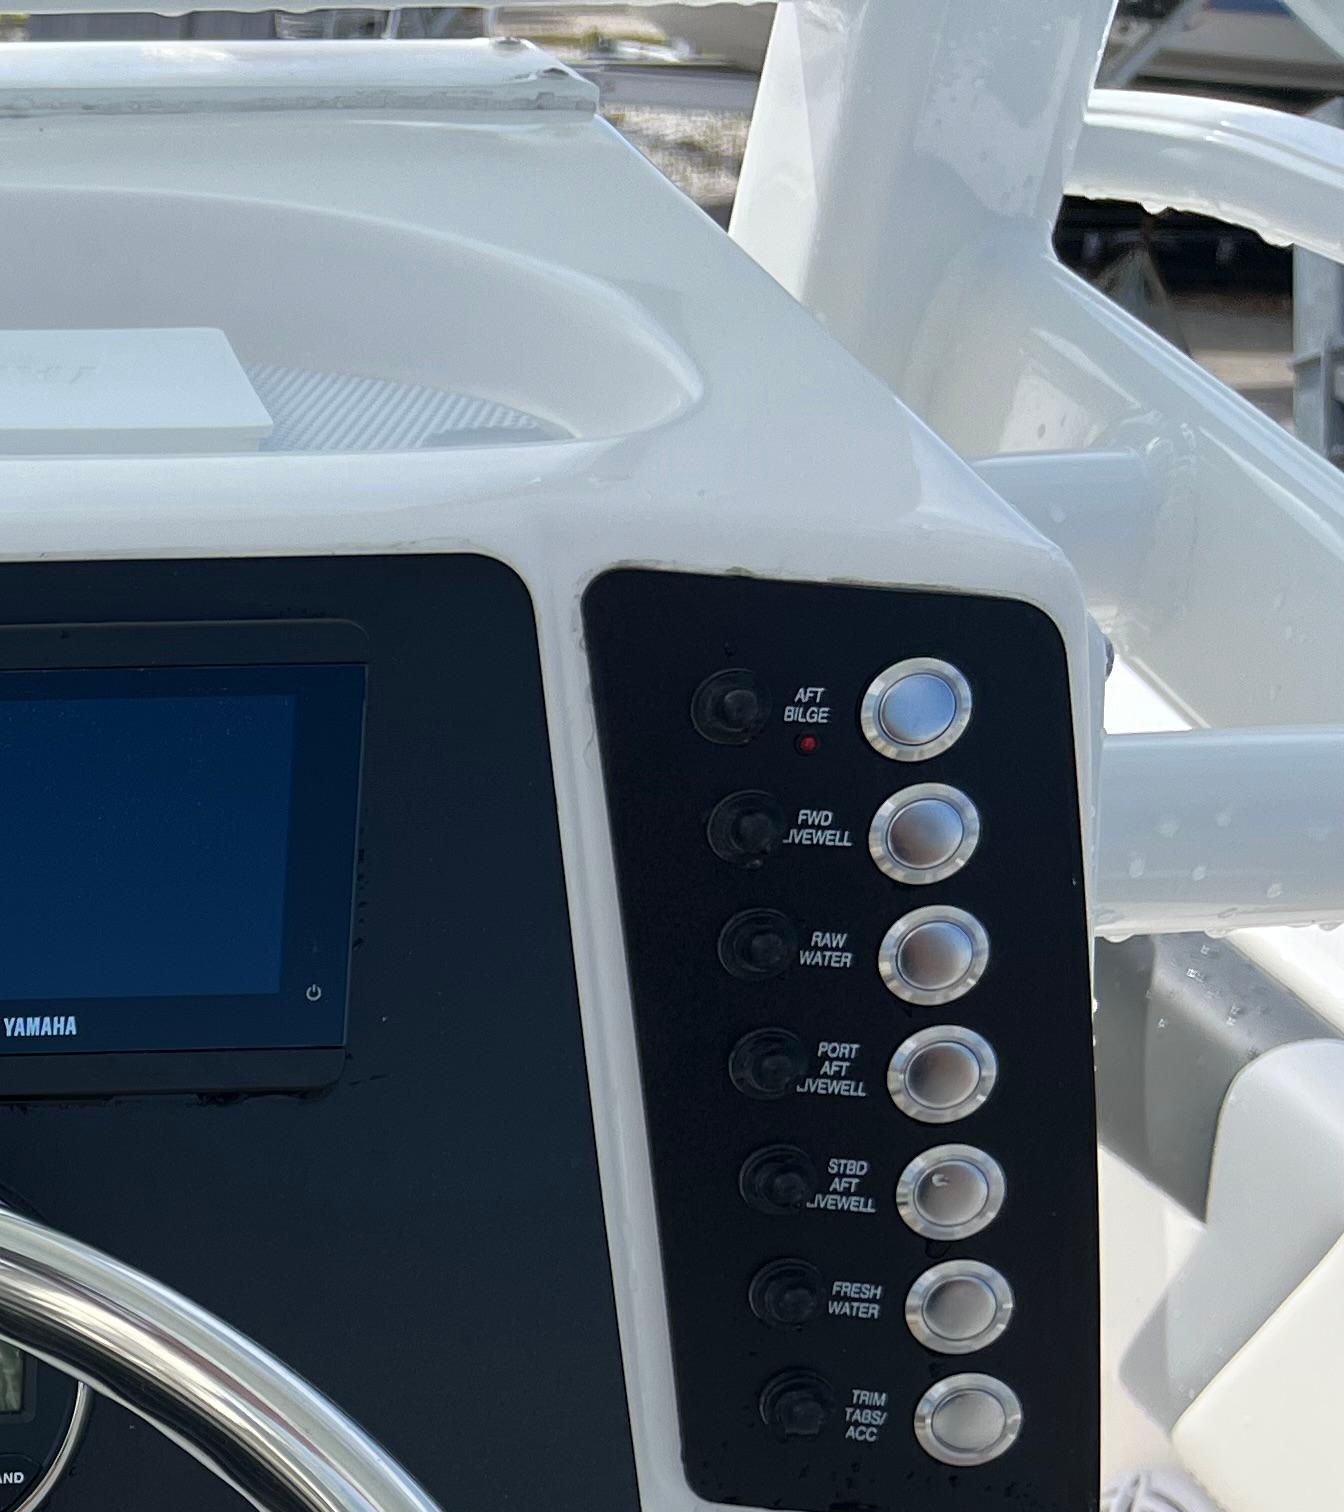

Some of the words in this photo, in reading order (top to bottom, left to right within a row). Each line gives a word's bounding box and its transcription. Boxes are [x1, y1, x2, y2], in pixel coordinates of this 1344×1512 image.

[794, 687, 825, 703] AFT
[784, 706, 829, 723] BILGE
[797, 809, 833, 826] FWD
[811, 931, 847, 948] RAW
[799, 950, 852, 968] WATER
[3, 1015, 76, 1037] YAMAHA
[817, 1042, 860, 1059] PORT
[820, 1061, 850, 1077] AFT
[827, 1158, 868, 1176] STBD
[829, 1177, 860, 1193] AFT
[832, 1281, 882, 1300] FRESH
[828, 1300, 880, 1319] WATER
[852, 1389, 886, 1406] TRIM
[845, 1407, 888, 1425] TABS/
[845, 1426, 878, 1442] ACC
